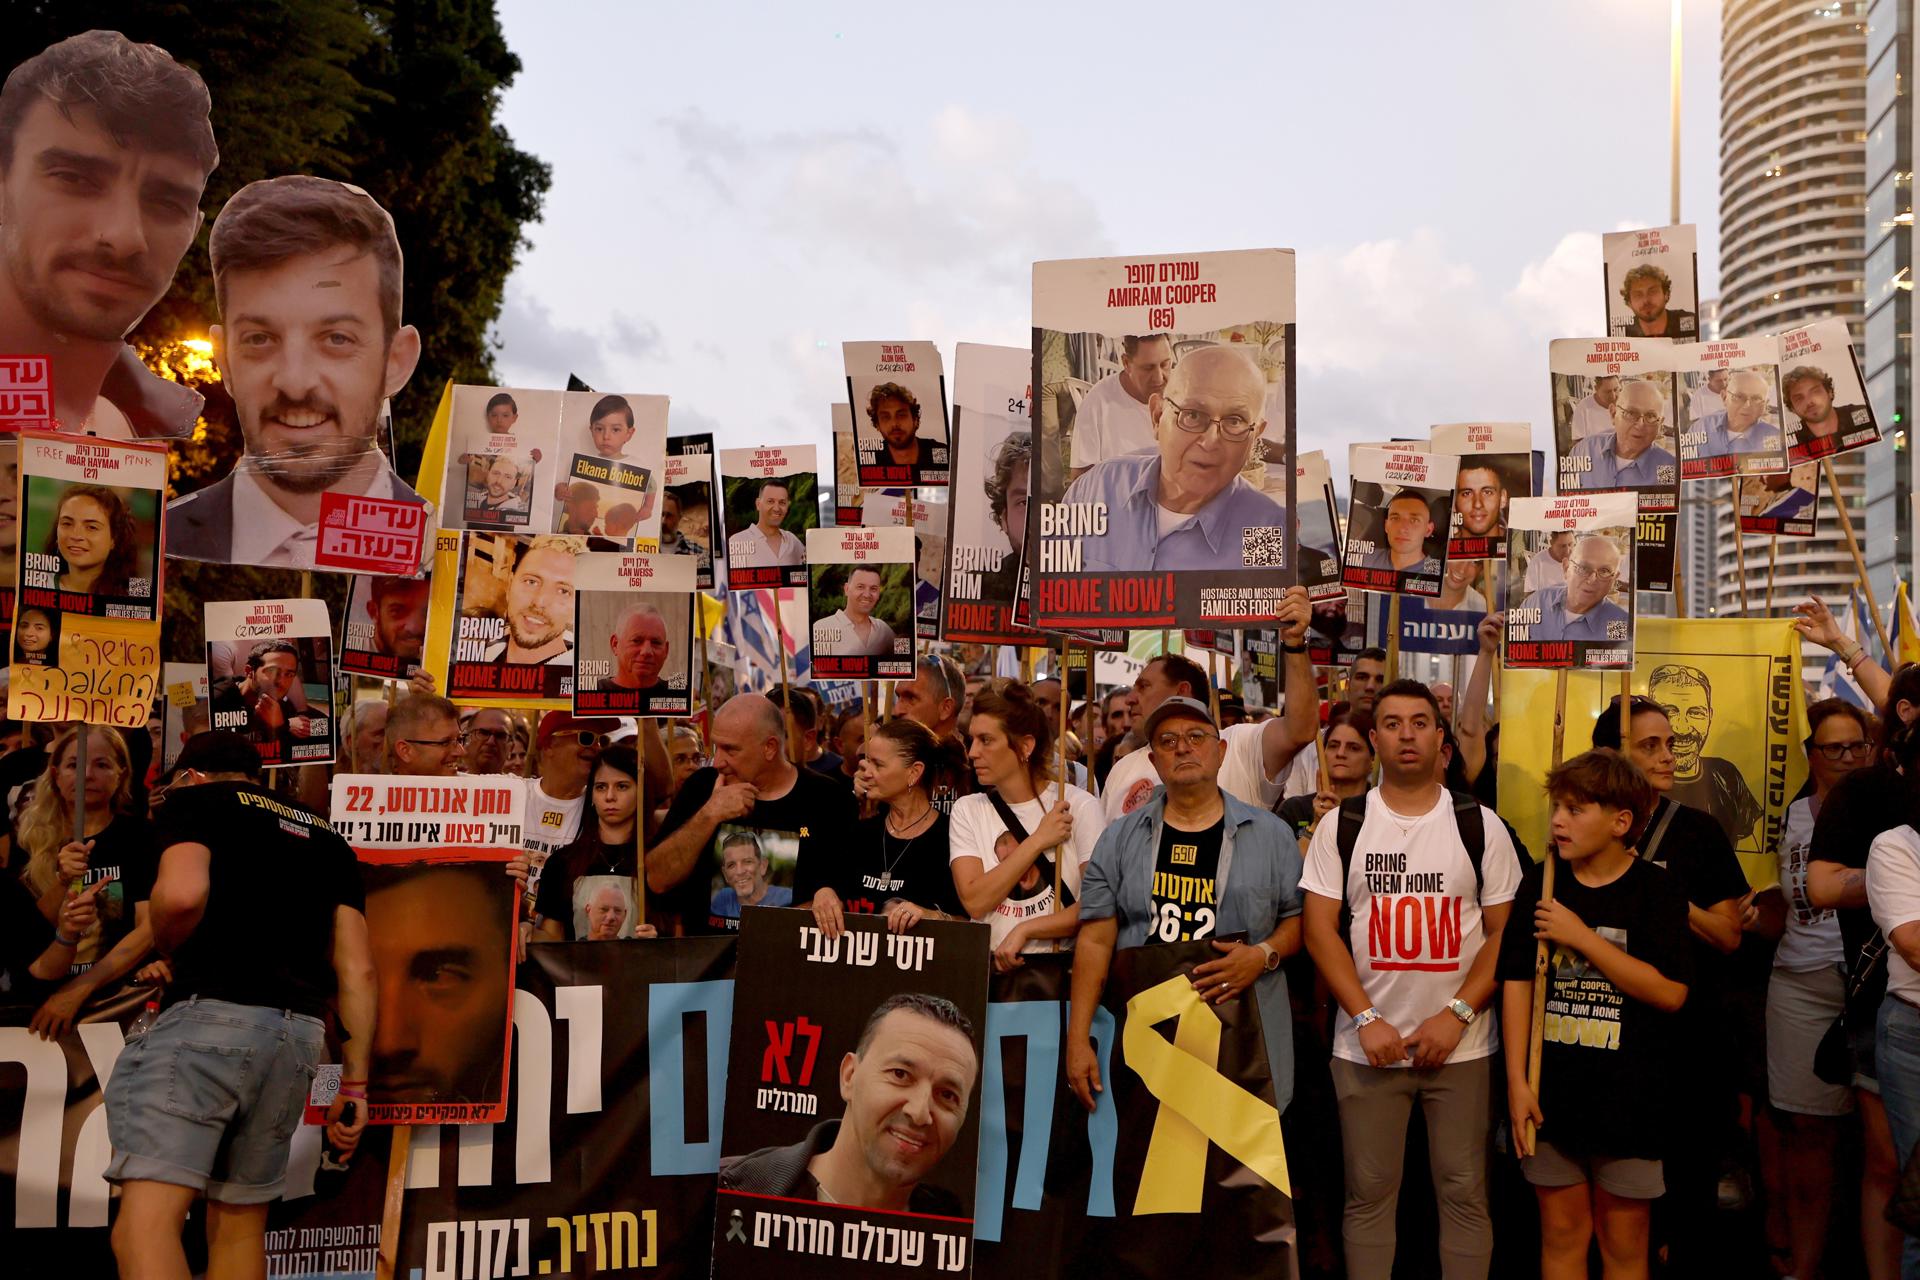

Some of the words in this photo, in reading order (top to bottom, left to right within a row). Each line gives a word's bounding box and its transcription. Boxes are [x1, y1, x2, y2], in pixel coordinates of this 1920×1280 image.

[1124, 264, 1155, 285] קופר
[1160, 262, 1199, 283] עמירם
[1107, 286, 1162, 308] AMIRAM
[1165, 283, 1216, 305] COOPER
[1148, 307, 1175, 330] (85)
[1587, 353, 1614, 363] AMIRAM
[1615, 352, 1639, 361] COOPER
[1700, 353, 1723, 361] AMIRAM
[1724, 350, 1745, 359] COOPER
[1607, 364, 1620, 373] (85)
[1008, 398, 1025, 415] 24
[858, 439, 884, 451] BRING
[1475, 434, 1492, 442] DANIEL
[1679, 432, 1707, 447] BRING
[36, 446, 63, 460] FREE
[859, 453, 876, 465] HIM
[1680, 447, 1699, 459] HIM
[66, 454, 86, 466] INBAR
[88, 457, 119, 470] HAYMAN
[750, 459, 763, 468] YOSSI
[763, 457, 787, 467] SHARABI
[1385, 462, 1404, 470] MATAN
[1404, 464, 1429, 473] ANGREST
[1560, 455, 1592, 472] BRING
[1682, 460, 1706, 474] HOME
[84, 468, 98, 480] (27)
[577, 460, 607, 479] Elkana
[610, 465, 644, 487] Bohbot
[1560, 473, 1580, 489] HIM
[352, 503, 417, 529] עדיין
[1040, 502, 1108, 537] BRING
[1544, 510, 1571, 519] AMIRAM
[1572, 508, 1597, 517] COOPER
[1563, 519, 1576, 528] (85)
[332, 533, 414, 560] בעזה.
[437, 537, 458, 551] 690
[729, 540, 755, 555] BRING
[841, 542, 853, 550] YOSI
[854, 542, 879, 550] SHARABI
[1348, 539, 1375, 554] BRING
[25, 552, 60, 573] BRING
[730, 556, 748, 568] HIM
[854, 551, 865, 560] (53)
[952, 545, 1002, 573] BRING
[1039, 540, 1083, 573] HIM
[1346, 554, 1364, 567] HIM
[24, 570, 50, 589] HER
[618, 568, 632, 577] ILAN
[633, 568, 653, 577] WEISS
[730, 569, 755, 584] HOME
[757, 567, 782, 583] NOW!
[1344, 568, 1369, 584] HOME
[629, 577, 642, 587] (56)
[950, 573, 982, 600] HIM
[1039, 579, 1101, 613] HOME
[1109, 573, 1176, 612] NOW!
[1201, 589, 1236, 600] HOSTAGES
[1238, 588, 1253, 599] AND
[1254, 587, 1286, 599] MISSING
[23, 589, 57, 607] HOME
[60, 594, 93, 615] NOW!
[1201, 600, 1248, 616] FAMILIES
[106, 609, 131, 618] FAMILIES
[132, 611, 151, 620] FORUM
[246, 616, 270, 624] NIMROD
[273, 614, 293, 623] COHEN
[949, 605, 994, 631] HOME
[1509, 608, 1542, 624] BRING
[348, 624, 375, 638] BRING
[459, 617, 505, 640] BRING
[813, 628, 841, 642] BRING
[1404, 622, 1474, 641] וענווה
[1509, 625, 1530, 641] HIM
[84, 638, 153, 666] האישה
[456, 641, 486, 662] HIM
[814, 643, 831, 655] HIM
[1508, 643, 1539, 660] HOME
[1542, 641, 1574, 660] NOW!
[813, 658, 840, 672] HOME
[841, 656, 869, 671] NOW!
[1586, 654, 1609, 663] FAMILIES
[1610, 654, 1628, 662] FORUM
[579, 660, 610, 675] BRING
[43, 667, 153, 701] החטופה
[454, 665, 496, 688] HOME
[501, 665, 544, 691] NOW!
[578, 677, 598, 690] HIM
[577, 692, 607, 707] HOME
[609, 692, 640, 708] NOW!
[1769, 655, 1792, 735] עכשיו
[20, 692, 145, 726] האחרונה
[670, 702, 687, 710] FORUM
[215, 710, 247, 727] BRING
[1770, 744, 1787, 807] כולם
[346, 786, 373, 812] 22
[379, 787, 468, 816] אנגרסט,
[473, 789, 511, 816] מתן
[542, 812, 563, 826] 690
[375, 823, 403, 842] סוג
[408, 823, 440, 843] אינו
[444, 824, 484, 843] פצוע
[489, 822, 521, 844] חייל
[1765, 815, 1782, 854] את
[1173, 846, 1195, 862] 690
[1365, 853, 1406, 873] BRING
[890, 880, 904, 891] יוסי
[1365, 874, 1402, 894] THEM
[1406, 873, 1444, 893] HOME
[1025, 904, 1036, 916] את
[1368, 896, 1462, 960] NOW
[800, 926, 878, 966] שרעבי
[887, 933, 935, 971] יוסי
[1588, 993, 1623, 1005] עמירם
[1547, 1000, 1569, 1013] BRING
[1571, 1004, 1590, 1016] HIM
[1592, 1007, 1620, 1020] HOME
[1544, 1013, 1621, 1050] NOW!
[761, 1016, 822, 1086] לא
[756, 1088, 818, 1115] מתרגלים
[299, 1225, 364, 1249] המשפחות
[538, 1209, 657, 1274] נחזיר.
[754, 1210, 834, 1256] חוזרים
[841, 1220, 925, 1268] שכולם
[933, 1234, 966, 1272] עד
